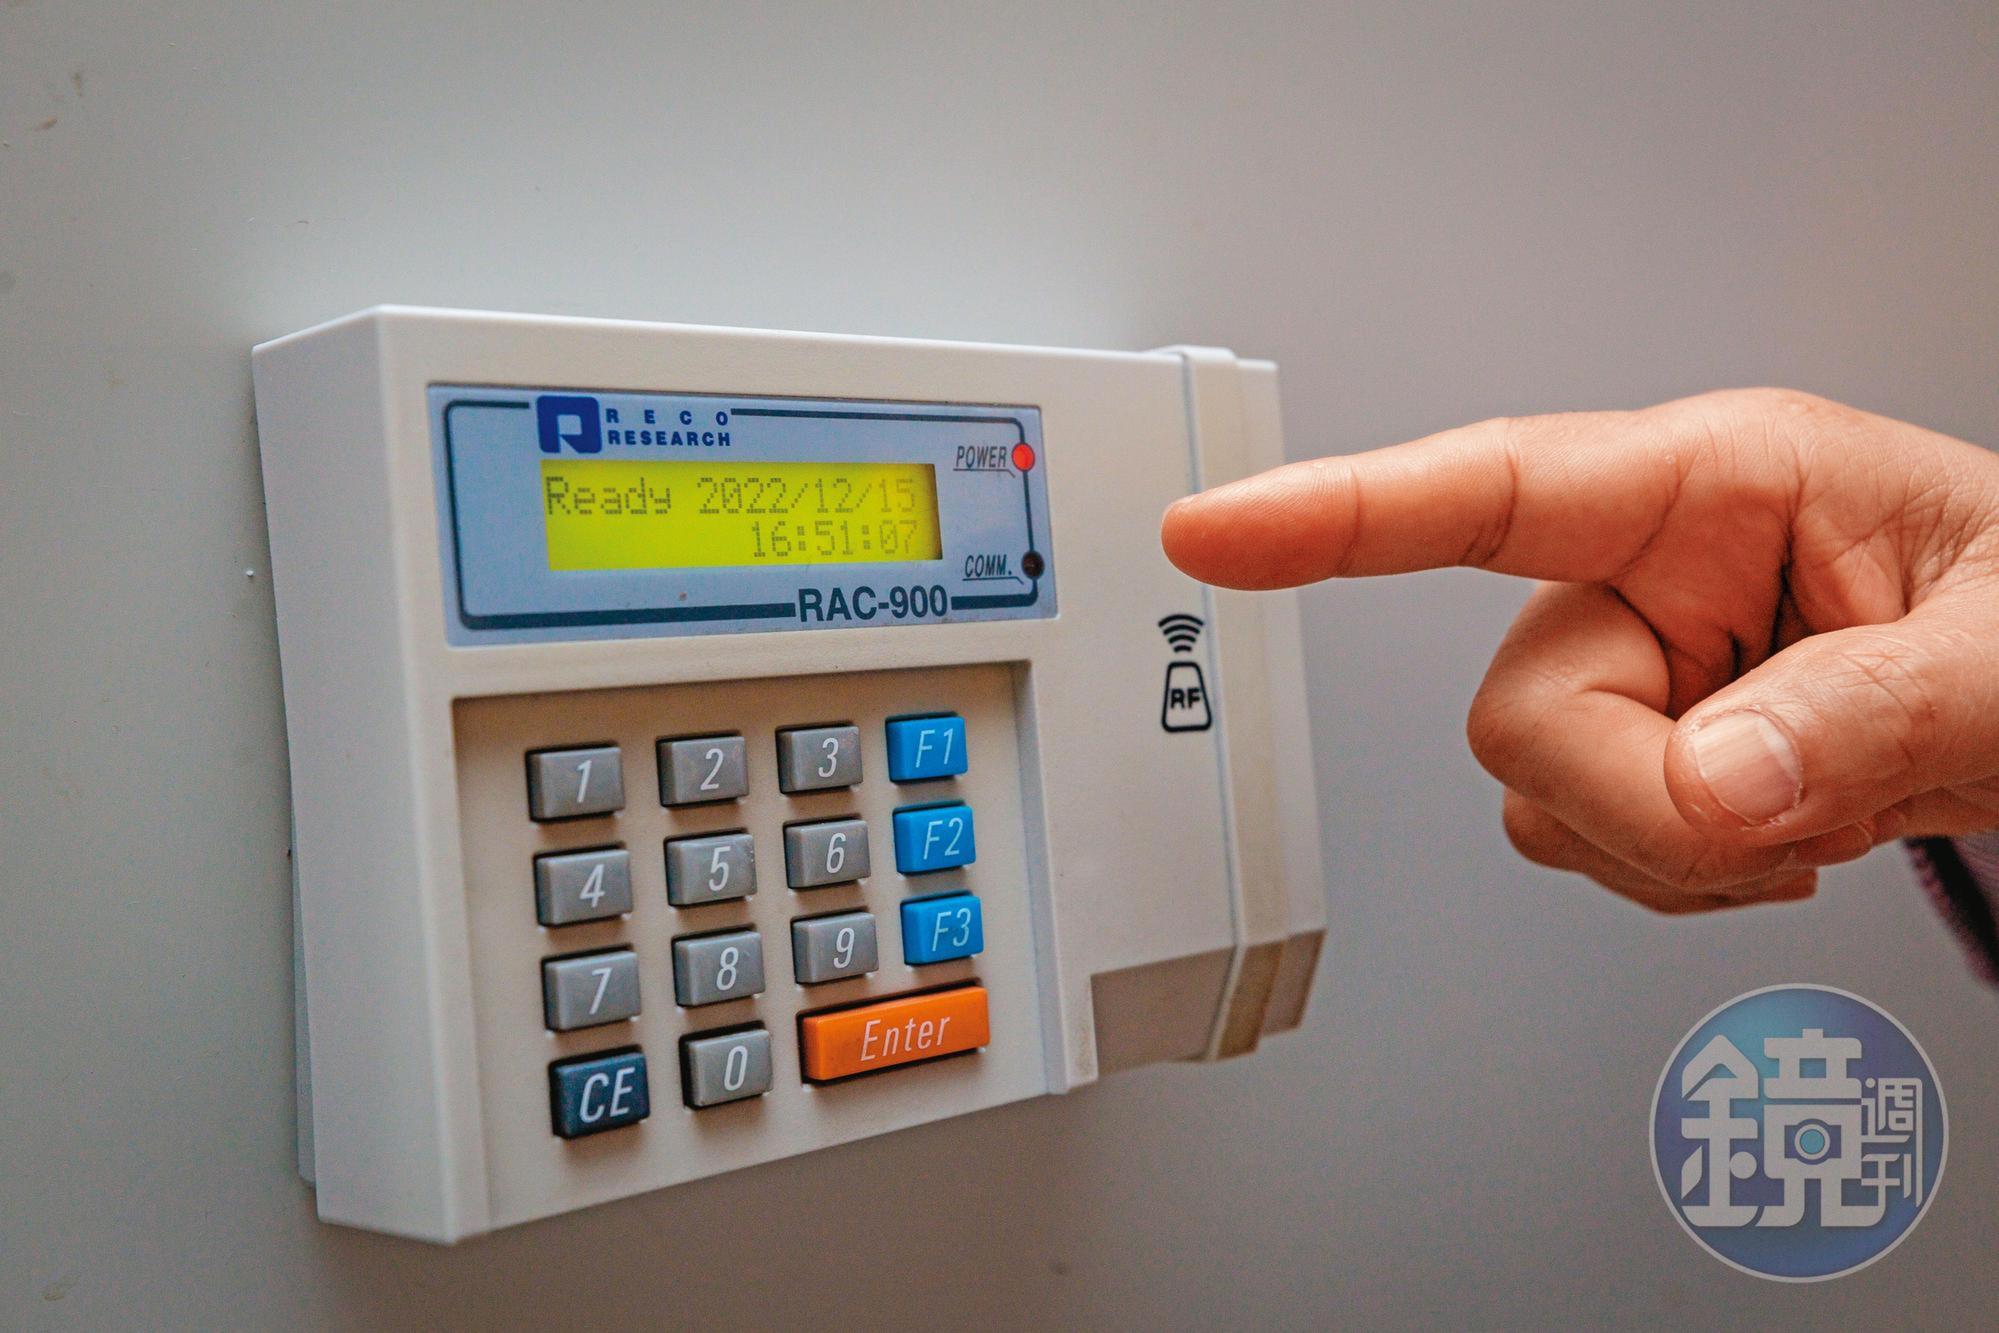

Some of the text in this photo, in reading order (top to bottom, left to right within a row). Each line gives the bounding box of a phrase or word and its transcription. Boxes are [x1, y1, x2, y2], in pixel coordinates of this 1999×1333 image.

[605, 408, 729, 427] RECO
[607, 429, 731, 447] RESEARCH
[956, 445, 1008, 469] POWER
[546, 476, 917, 515] Ready 2022/12/15
[752, 519, 918, 558] 16:51:07
[965, 554, 1013, 578] COMM.
[798, 584, 948, 622] RAC-900
[1170, 687, 1201, 710] RF
[701, 748, 724, 790] 2
[818, 737, 838, 778] 3
[915, 727, 954, 769] F1
[576, 759, 591, 803] 1
[826, 832, 846, 873] 6
[923, 817, 963, 860] F2
[580, 864, 605, 908] 4
[709, 846, 730, 891] 5
[834, 927, 855, 969] 9
[931, 907, 971, 951] F3
[716, 946, 739, 990] 8
[588, 968, 611, 1014] 7
[860, 1016, 951, 1062] Enter
[724, 1045, 748, 1091] 0
[580, 1066, 635, 1124] CE
